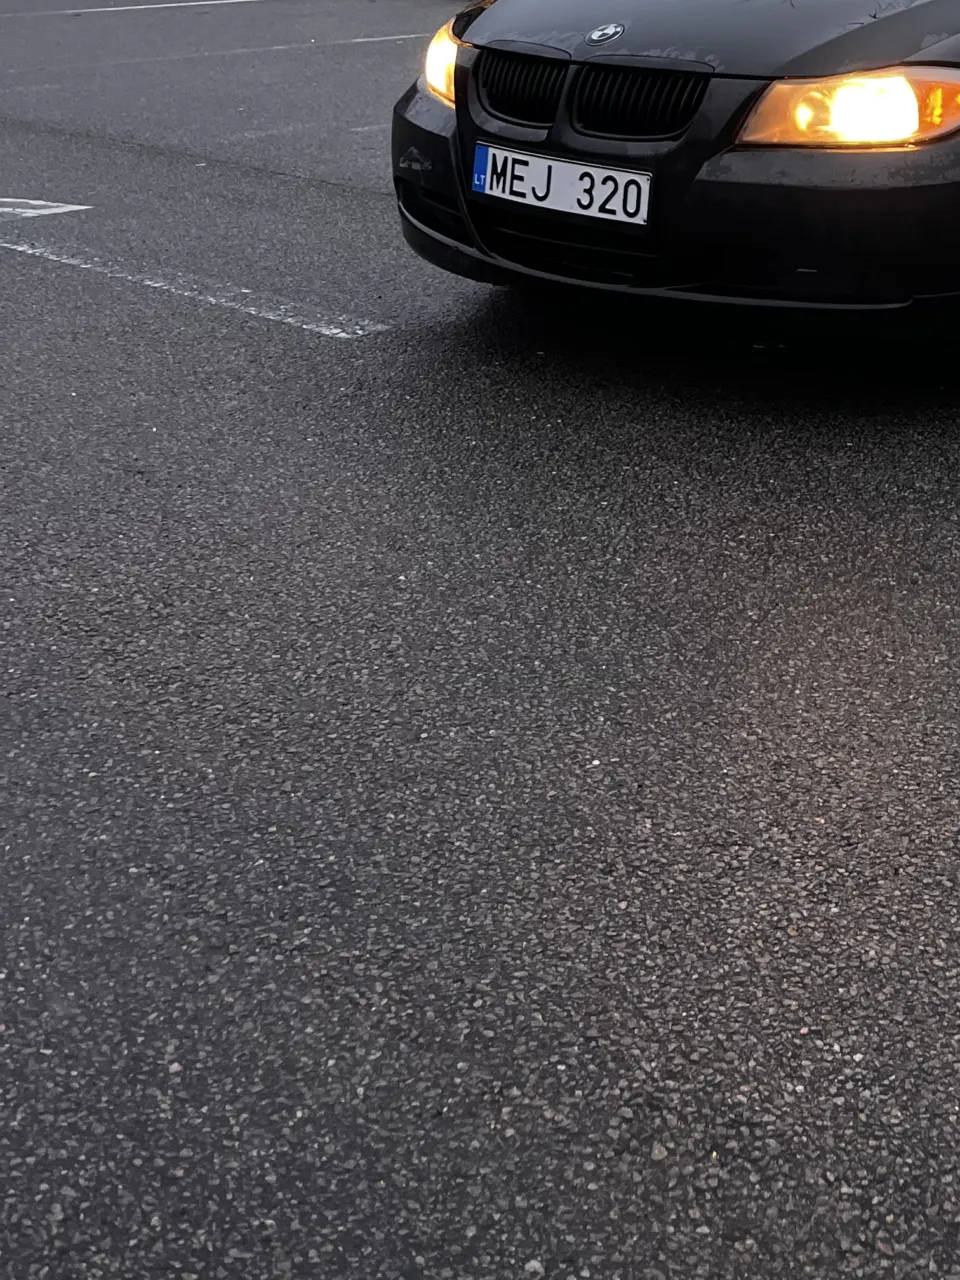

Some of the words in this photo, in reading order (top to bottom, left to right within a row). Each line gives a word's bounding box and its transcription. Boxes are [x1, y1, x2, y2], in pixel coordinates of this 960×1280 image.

[474, 174, 486, 186] LT
[489, 153, 552, 202] MEJ
[576, 171, 642, 218] 320
